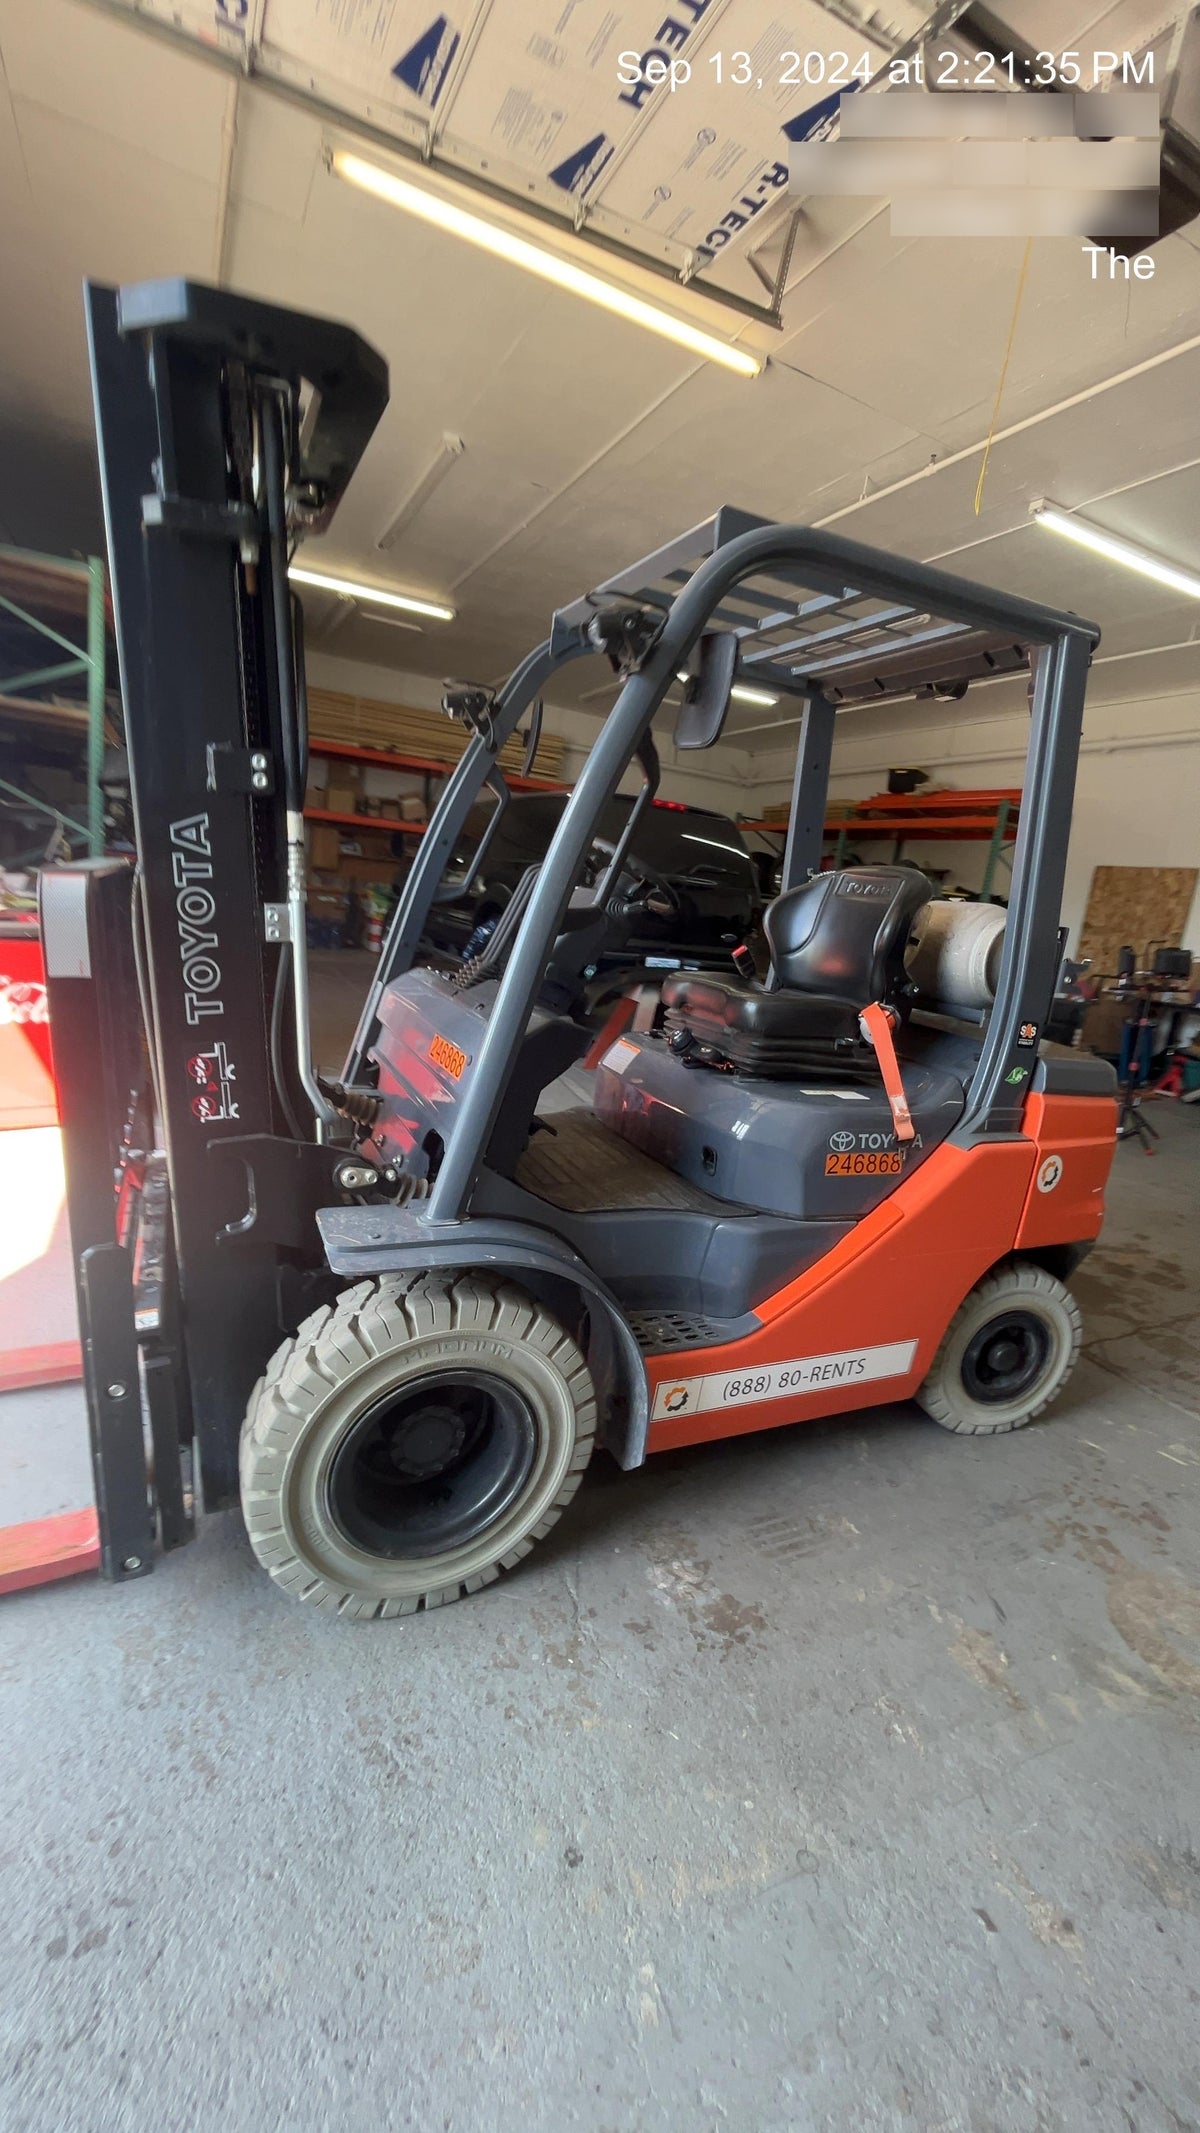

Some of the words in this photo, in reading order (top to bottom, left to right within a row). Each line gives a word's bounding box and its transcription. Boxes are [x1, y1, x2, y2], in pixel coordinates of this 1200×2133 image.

[169, 811, 225, 1026] TOYOTA
[430, 1035, 465, 1078] 246868
[858, 1133, 924, 1150] TOYA
[826, 1153, 901, 1175] 246868
[722, 1374, 772, 1401] (888)
[778, 1357, 867, 1389] 80-RENTS
